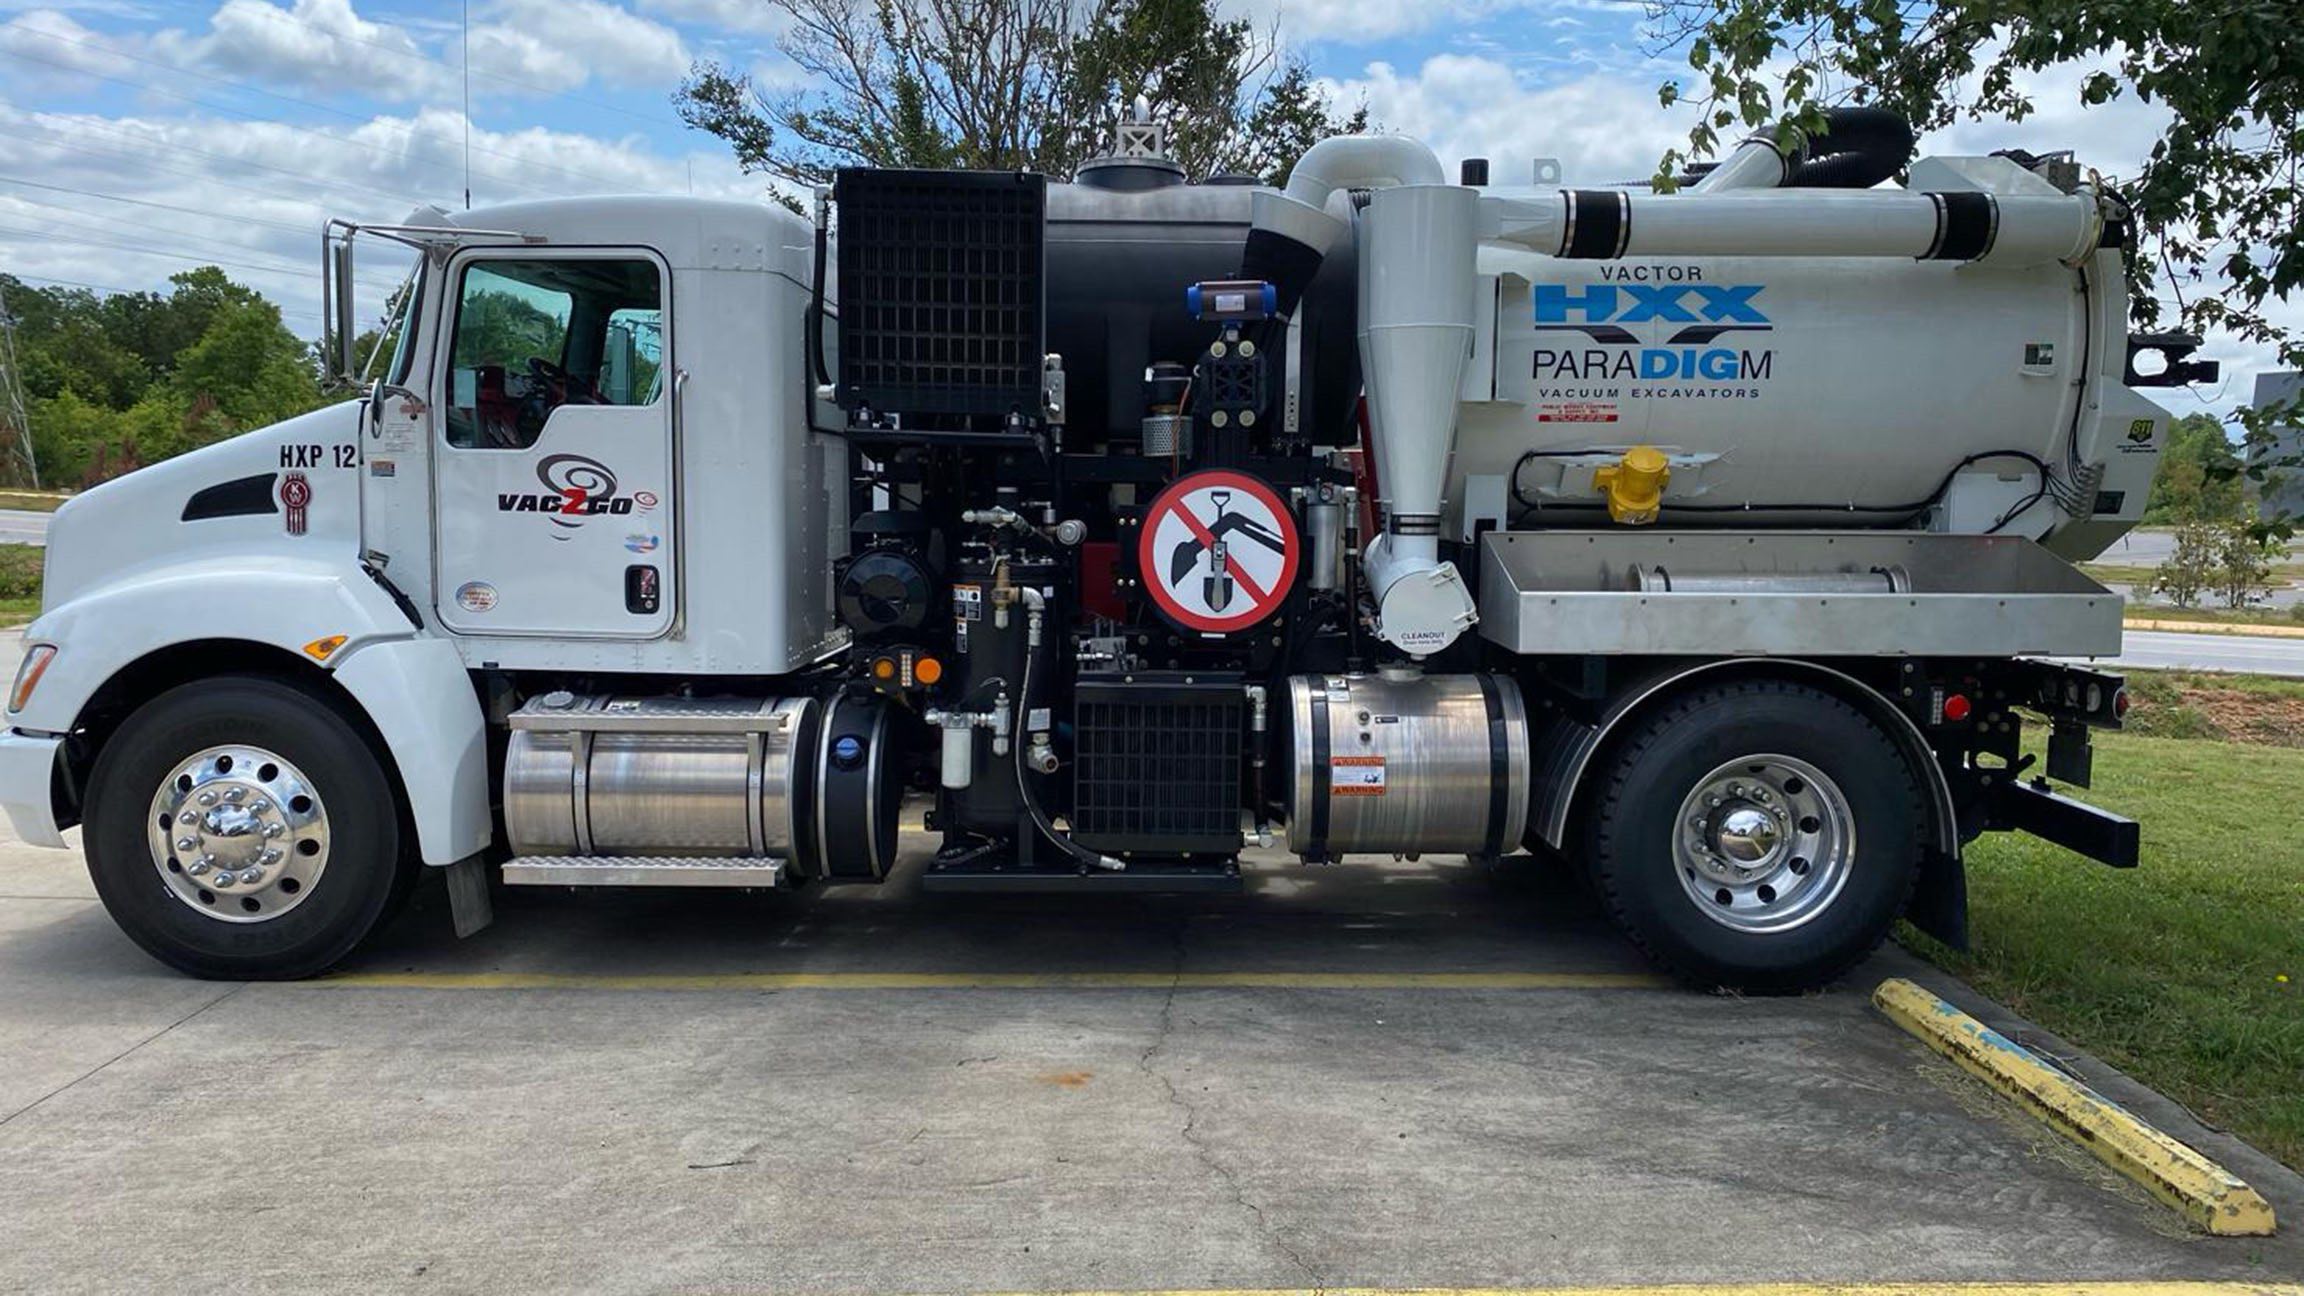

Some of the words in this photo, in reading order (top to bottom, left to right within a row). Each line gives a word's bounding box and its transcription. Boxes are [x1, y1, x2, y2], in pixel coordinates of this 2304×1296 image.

[1600, 266, 1702, 280] VACTOR
[1535, 285, 1771, 322] HXX
[1532, 349, 1772, 380] PARADIGM
[1539, 389, 1619, 398] VACUUM
[1631, 389, 1760, 398] EXCAVATORS
[2131, 421, 2153, 435] 811
[280, 445, 322, 467] HXP
[333, 445, 356, 467] 12
[498, 488, 633, 516] VAC2GO
[1342, 786, 1383, 794] WARNING
